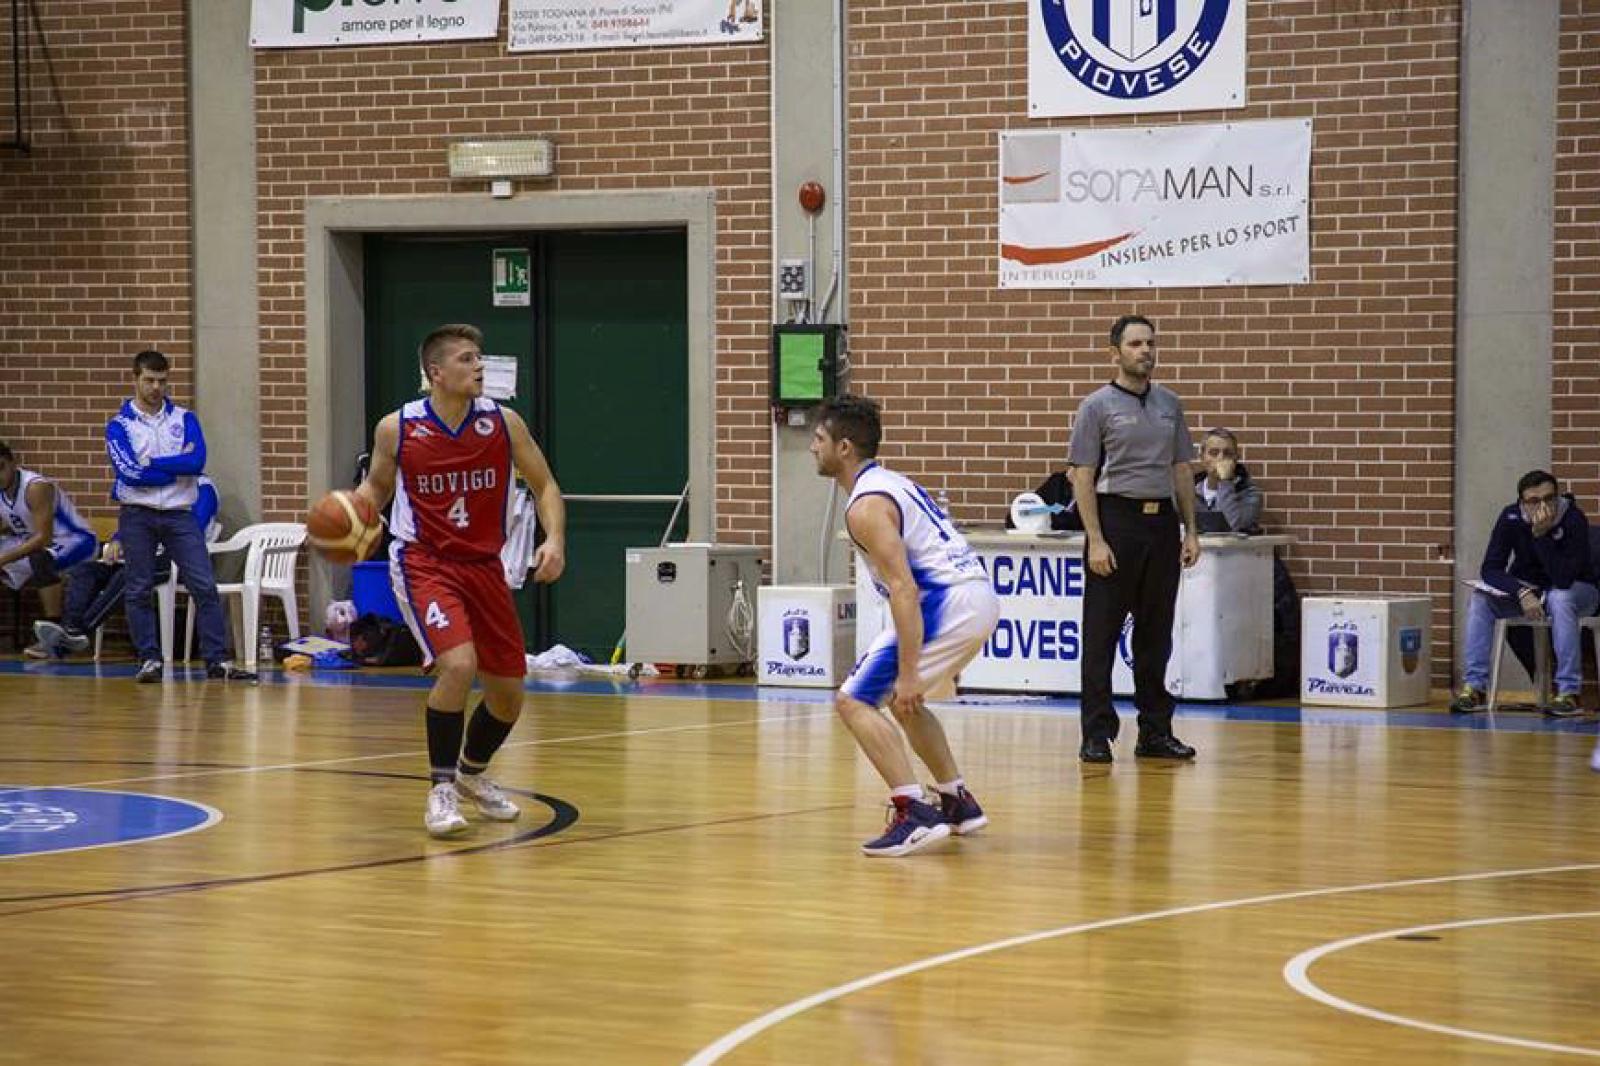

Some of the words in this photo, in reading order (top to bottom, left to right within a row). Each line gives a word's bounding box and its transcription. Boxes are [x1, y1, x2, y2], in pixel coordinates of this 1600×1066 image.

[341, 20, 386, 32] amore
[389, 18, 413, 33] per
[415, 16, 424, 28] il
[427, 14, 465, 29] legno
[1060, 30, 1211, 95] PIOVESE
[1100, 239, 1175, 268] INSIEME
[1179, 231, 1212, 255] PER
[1216, 227, 1238, 248] LO
[1243, 214, 1300, 243] SPORT
[1002, 269, 1097, 282] INTERIORS
[415, 468, 497, 495] ROVIGO
[447, 497, 470, 528] 4
[425, 600, 450, 629] 4
